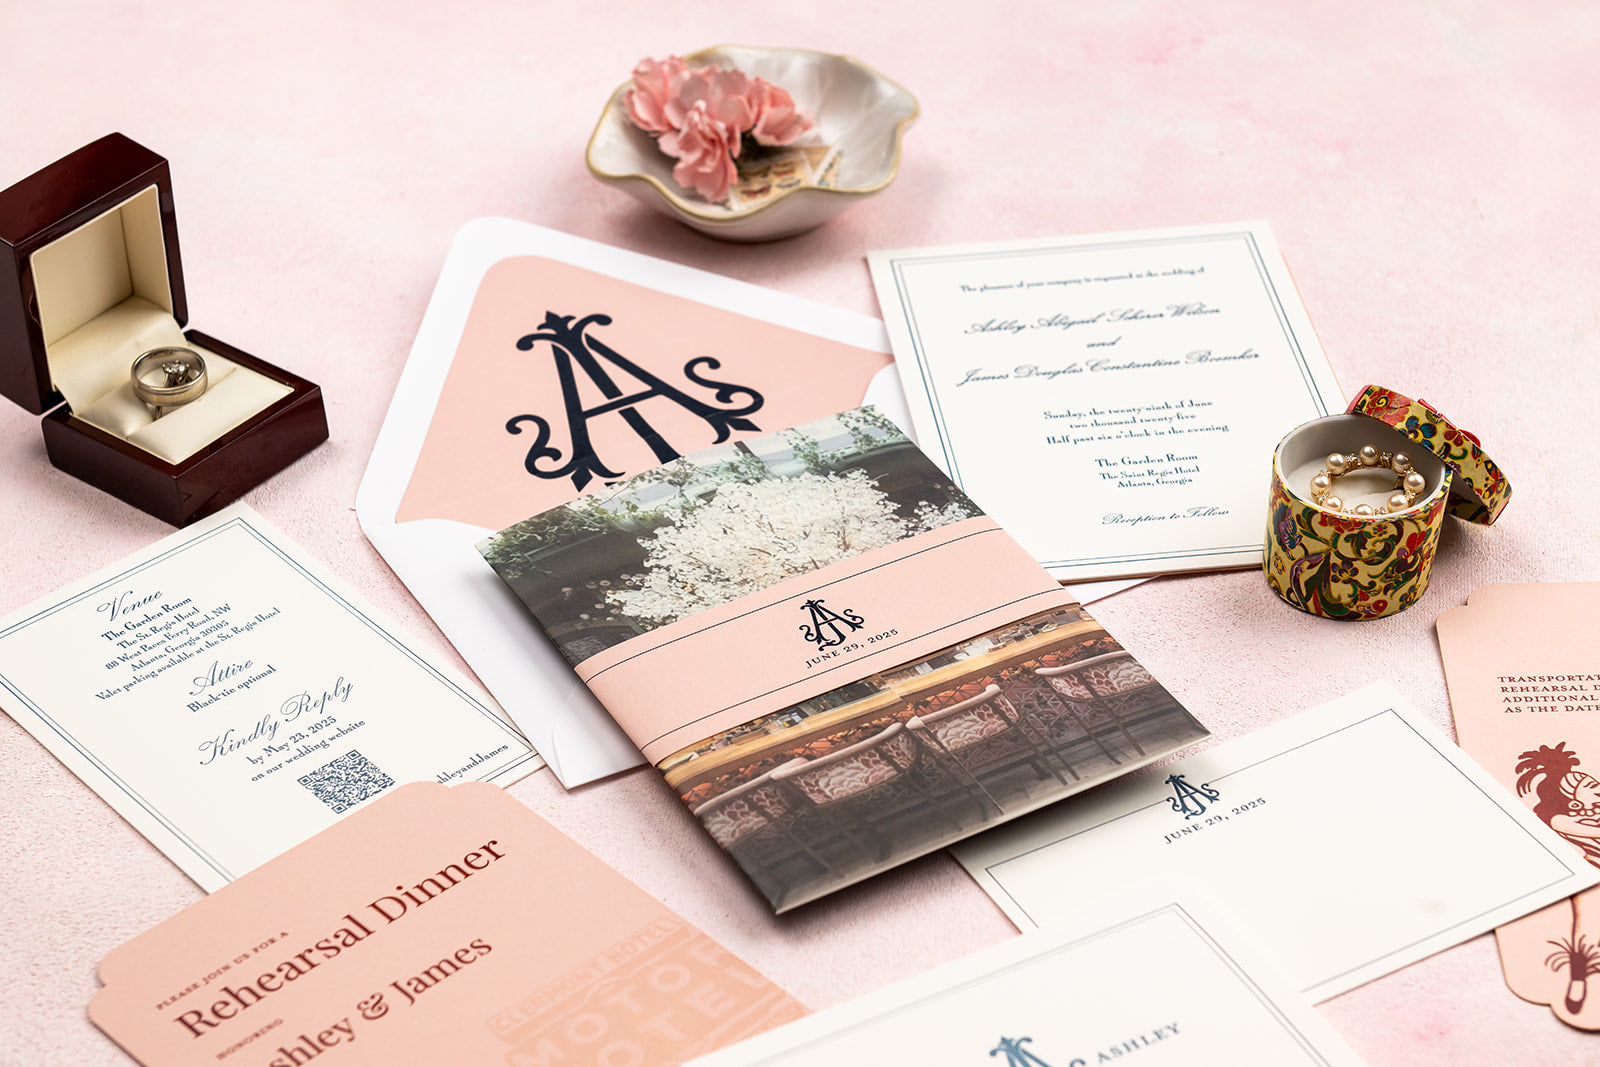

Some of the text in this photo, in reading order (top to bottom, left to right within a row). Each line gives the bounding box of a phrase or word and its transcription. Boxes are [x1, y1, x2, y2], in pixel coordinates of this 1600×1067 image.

[964, 318, 1026, 335] Ashley
[1086, 335, 1122, 348] and
[956, 367, 1009, 388] James
[1013, 363, 1083, 380] Douglas
[1085, 358, 1180, 373] Constantine
[1043, 409, 1087, 420] Sunday,
[1089, 407, 1105, 416] the
[1175, 399, 1184, 409] of
[1188, 399, 1214, 408] June
[1090, 416, 1137, 428] thousand
[1046, 434, 1070, 445] Half
[1073, 435, 1094, 445] past
[1168, 426, 1184, 434] the
[1187, 424, 1230, 433] evening
[1094, 453, 1198, 468] The Garden Room
[1099, 465, 1200, 480] The Saint Regis Hotel
[1117, 476, 1193, 488] Atlanta, Georgia
[1102, 505, 1229, 527] Reception to Follow
[96, 590, 163, 622] Venue
[101, 597, 192, 642] The Garden Room
[105, 603, 232, 670] 88 West Paces Ferry Road, NW
[116, 606, 200, 650] The St. Regis Hotel
[130, 619, 230, 672] Atlanta, Georgia 30305
[805, 628, 899, 669] JUNE 29, 2025
[95, 606, 281, 701] Valet parking available at the St. Regis Hotel
[189, 660, 254, 696] Attire
[237, 664, 278, 689] optional
[1500, 684, 1588, 693] REHEARSAL
[1503, 694, 1599, 703] ADDITIONAL
[1504, 705, 1522, 713] AS
[1527, 705, 1559, 713] THE
[198, 676, 354, 766] Kindly Reply
[246, 715, 337, 766] by May 23, 2025
[251, 719, 366, 782] on our wedding website
[1163, 797, 1266, 845] JUNE 29, 2025
[172, 838, 506, 1039] Rehearsal Dinner
[156, 981, 200, 1010] PLEASE
[202, 963, 232, 986] JOIN
[233, 953, 251, 965] US
[252, 937, 278, 954] FOR
[494, 920, 676, 1033] CLERMONT HOTEL
[269, 937, 493, 1067] shley & James
[597, 965, 770, 1067] OTEL
[215, 1018, 285, 1060] HONORING
[1097, 1021, 1180, 1064] ASHLEY
